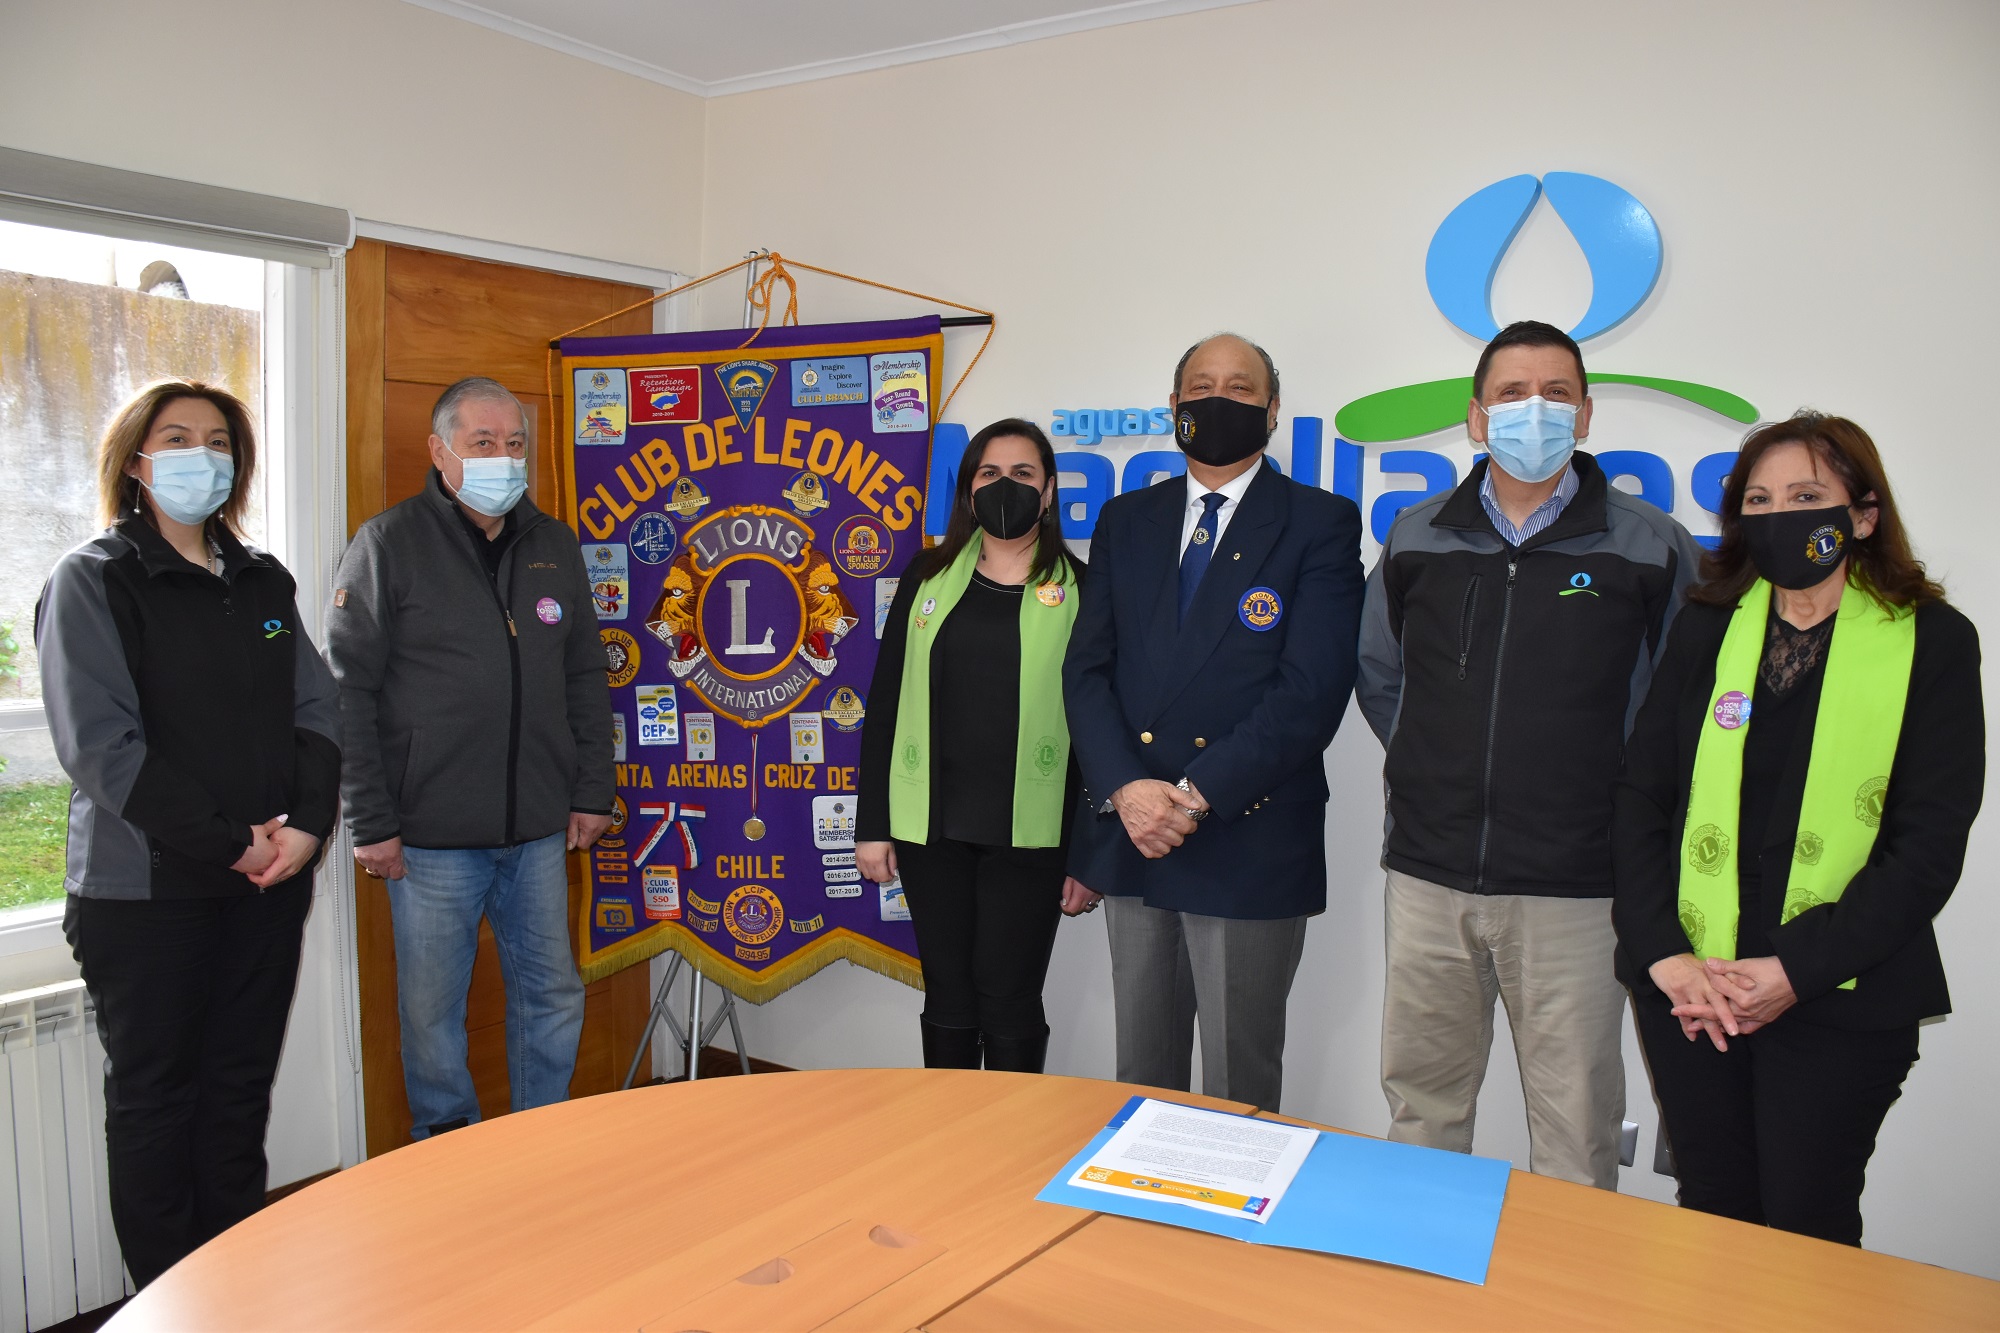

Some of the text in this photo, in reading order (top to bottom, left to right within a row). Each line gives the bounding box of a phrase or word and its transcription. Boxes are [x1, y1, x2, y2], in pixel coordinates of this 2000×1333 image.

[821, 364, 846, 372] Imagine
[873, 360, 921, 371] Membership
[829, 373, 852, 381] Explore
[880, 371, 917, 381] Excellence
[640, 377, 685, 387] Retention
[645, 384, 693, 394] Campaign
[580, 391, 622, 401] Membership
[825, 392, 863, 402] BRANCH
[585, 400, 618, 409] Excellence
[896, 400, 914, 410] Growth
[1051, 407, 1175, 446] aguas
[580, 415, 922, 540] CLUB DE LEONES
[1811, 526, 1834, 540] LIONS
[695, 519, 803, 563] LIONS
[1819, 538, 1833, 554] L
[847, 555, 880, 563] NEW CLUB
[587, 565, 626, 575] Membership
[848, 562, 879, 570] SPONSOR
[1251, 593, 1273, 602] LIONS
[1255, 602, 1266, 615] L
[725, 580, 775, 655] L
[610, 631, 633, 648] CLUB
[607, 663, 636, 685] ONSOR
[694, 668, 812, 709] INTERNATIONAL
[642, 724, 667, 737] CEP
[615, 763, 654, 789] NTA
[667, 763, 748, 788] ARENAS
[765, 764, 816, 789] CRUZ
[827, 766, 856, 791] DE
[1701, 840, 1716, 860] L
[1801, 842, 1813, 855] L
[716, 855, 785, 879] CHILE
[649, 879, 669, 887] CLUB
[647, 886, 673, 894] GIVING
[743, 886, 766, 894] LCIF
[653, 895, 669, 903] $50
[688, 893, 717, 912] 2019-2020
[749, 905, 758, 916] L
[688, 913, 716, 931] 2008-09
[725, 901, 782, 942] MELVIN JONES FELLOWSHIP
[740, 919, 767, 930] FOUNDATION
[792, 917, 821, 932] 2010-11
[736, 948, 769, 960] 1994-95
